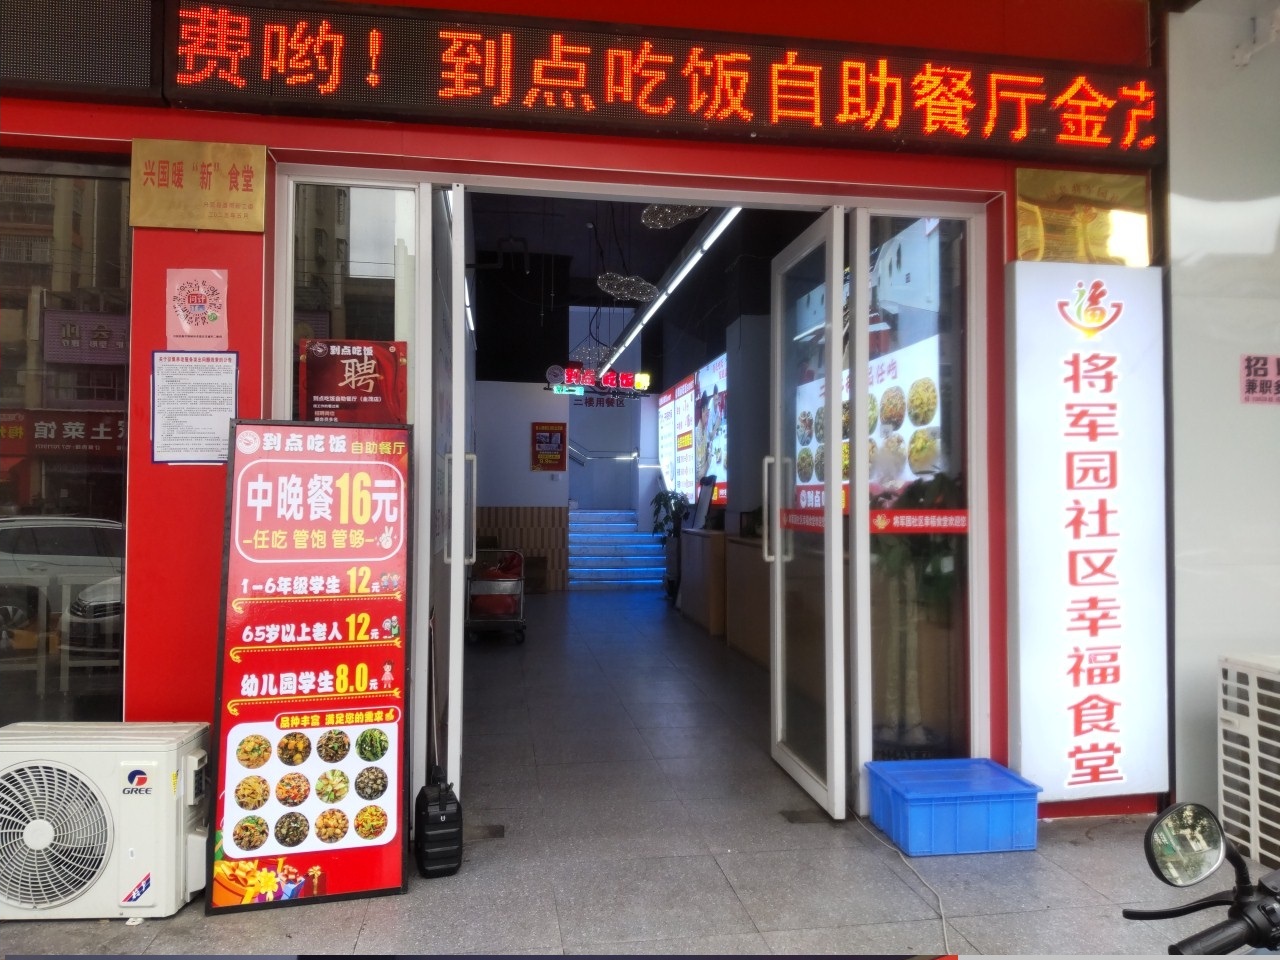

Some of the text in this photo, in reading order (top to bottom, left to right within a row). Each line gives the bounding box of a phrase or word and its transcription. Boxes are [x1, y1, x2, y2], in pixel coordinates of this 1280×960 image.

[330, 346, 373, 356] 到点吃饭
[338, 355, 384, 393] 聘
[263, 433, 405, 455] 到点吃饭 自助餐厅
[246, 472, 399, 525] 中晚餐16元
[253, 529, 366, 549] 任吃 管饱 管够
[241, 566, 381, 595] 1-6年级学生 12元
[1064, 353, 1123, 788] 将军园社区幸福食堂
[242, 613, 379, 644] 65岁以上老人 12元
[122, 787, 152, 795] GREE
